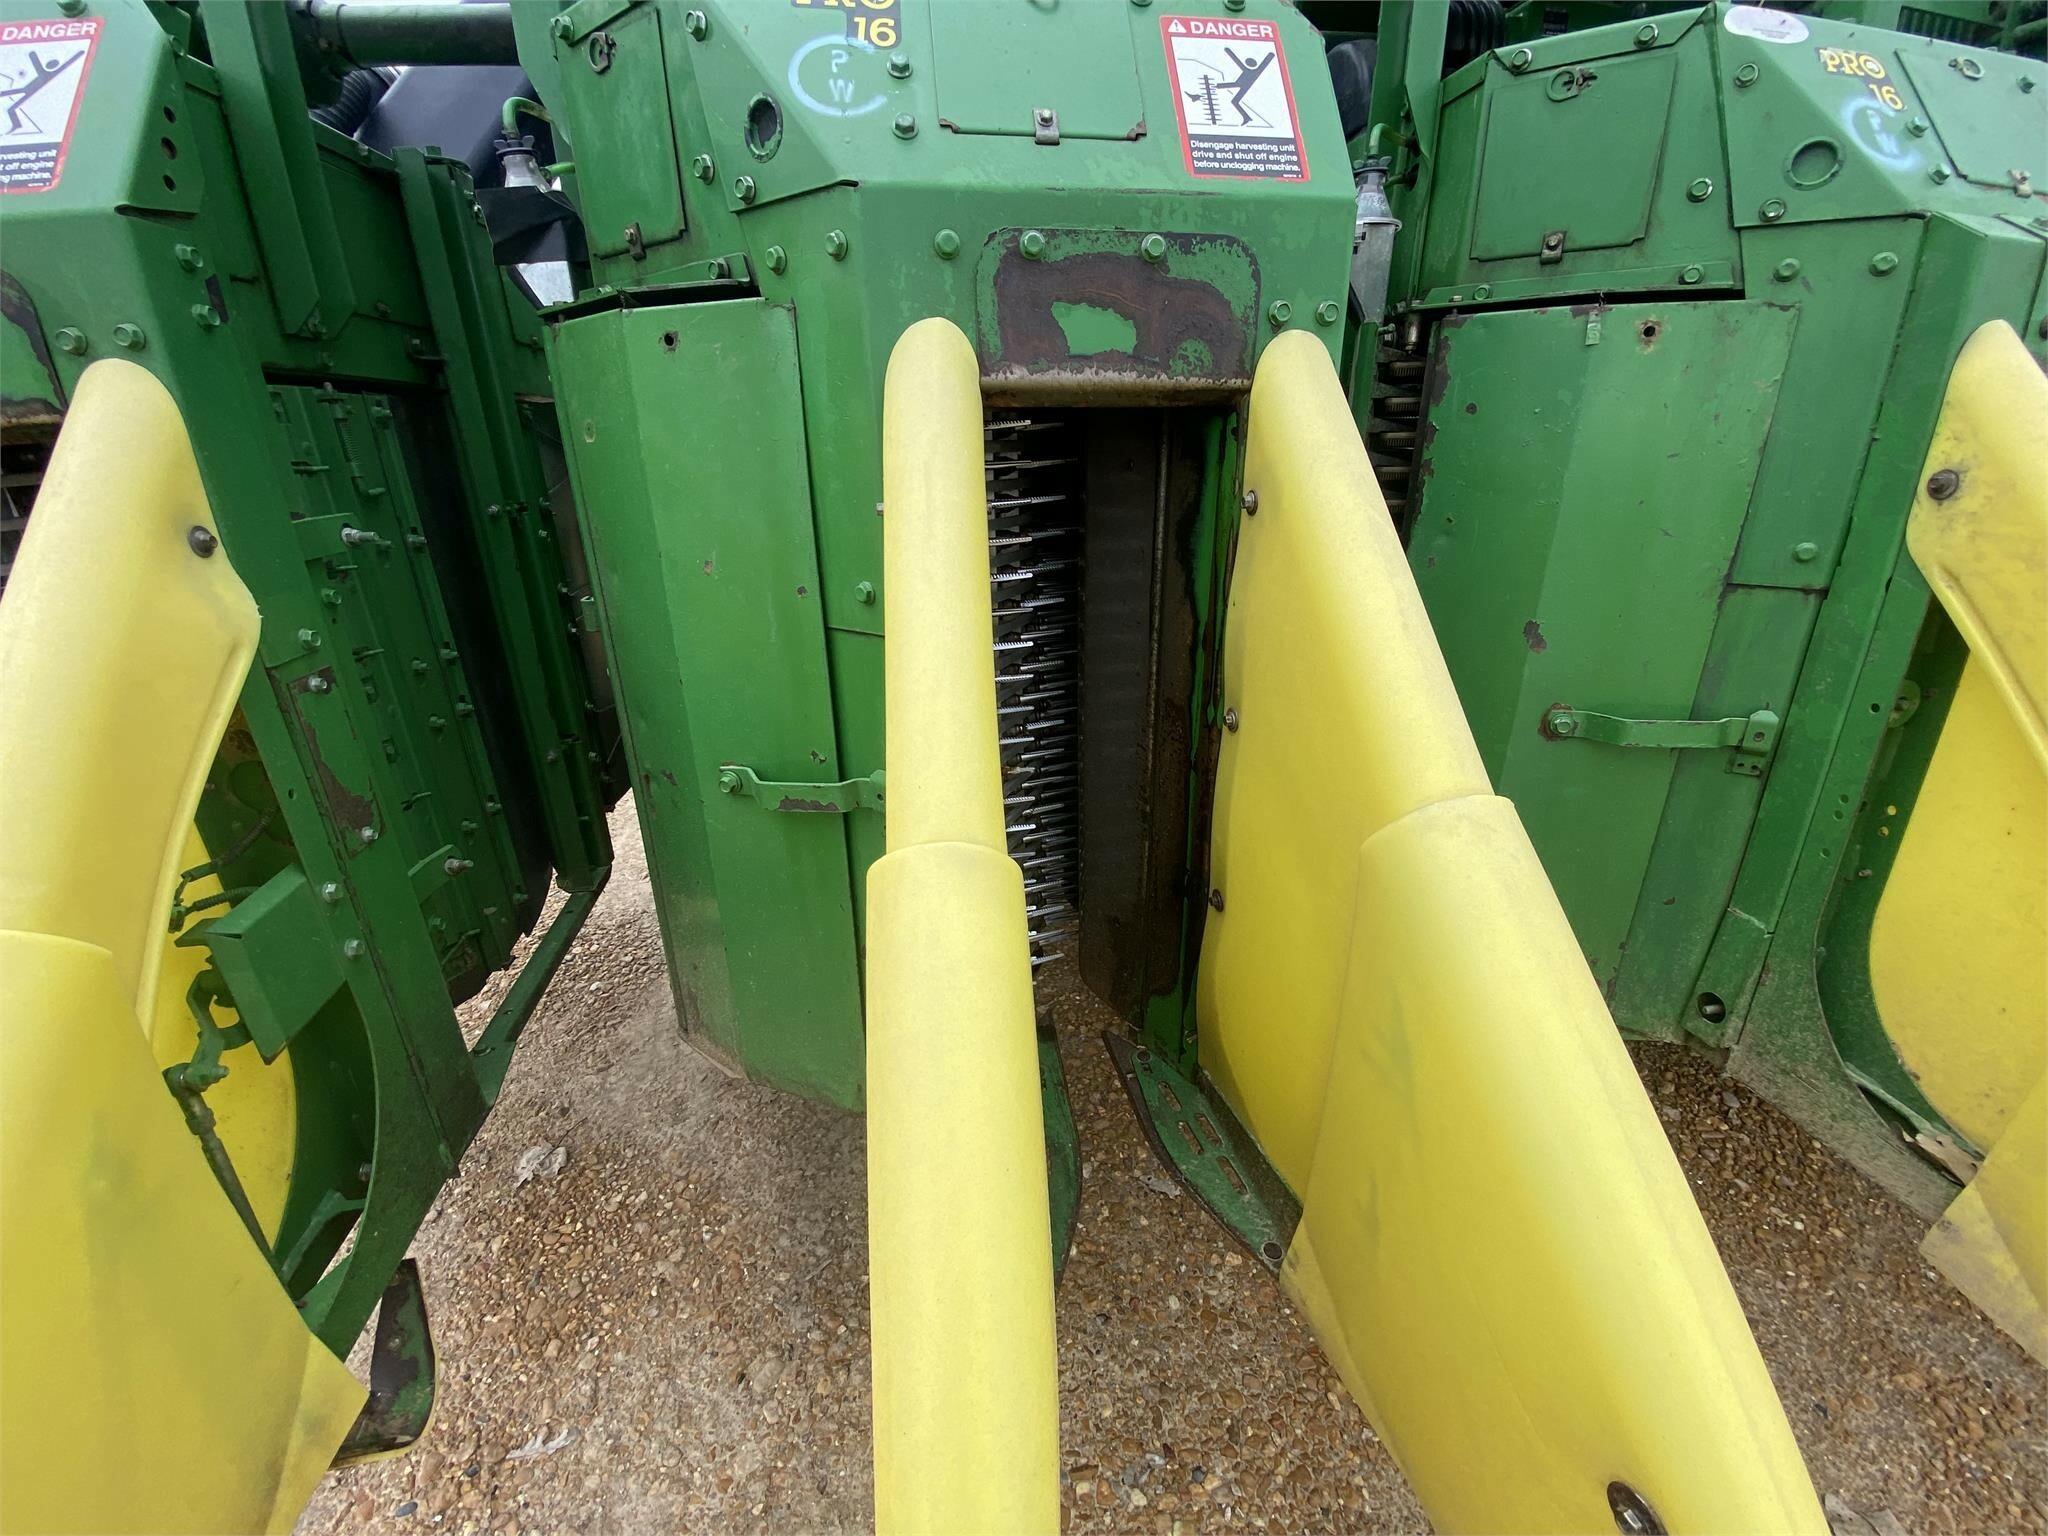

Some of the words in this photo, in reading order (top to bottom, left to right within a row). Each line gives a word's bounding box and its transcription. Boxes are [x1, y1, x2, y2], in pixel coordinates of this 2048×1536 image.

[2, 21, 97, 41] DANGER
[853, 17, 897, 47] 16
[1190, 21, 1274, 38] DANGER
[1819, 48, 1886, 79] PRO
[829, 78, 855, 103] W
[1868, 84, 1904, 110] 16
[1190, 139, 1234, 150] Disengage
[1235, 141, 1278, 152] harvesting
[1279, 144, 1295, 152] unit
[38, 149, 57, 158] unit
[1192, 150, 1214, 158] drive
[1216, 151, 1233, 159] and
[1234, 152, 1254, 160] shut
[1256, 153, 1267, 161] off
[1269, 154, 1298, 163] engine
[5, 162, 19, 170] off
[21, 161, 54, 170] engine
[1194, 160, 1219, 168] before
[1220, 161, 1265, 172] unclogging
[1265, 163, 1301, 172] machine.
[11, 171, 52, 181] machine.
